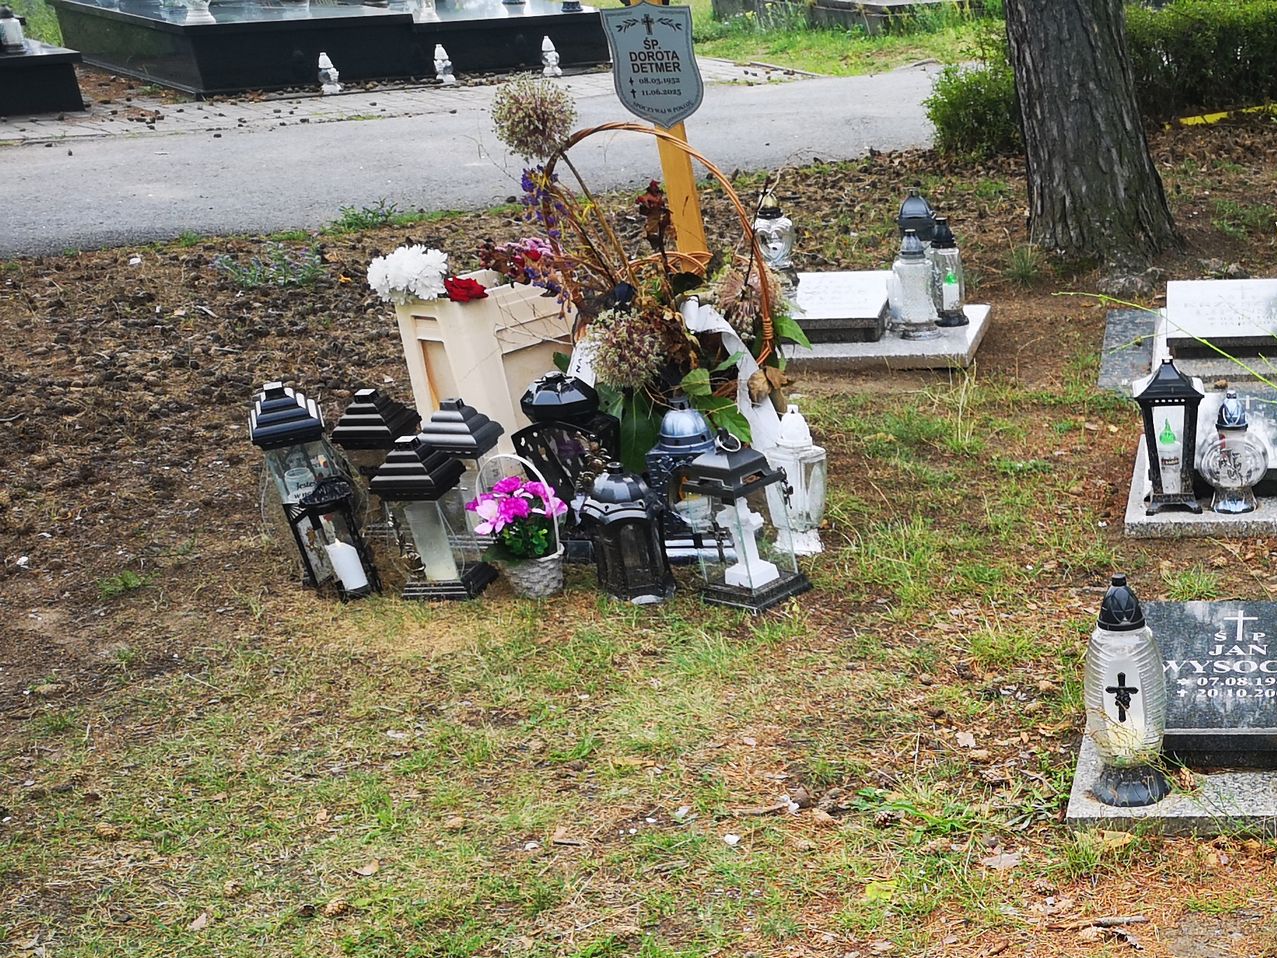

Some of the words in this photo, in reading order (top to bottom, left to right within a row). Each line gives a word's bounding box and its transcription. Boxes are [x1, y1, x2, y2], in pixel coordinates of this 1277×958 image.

[643, 37, 661, 50] ŚP.
[629, 51, 680, 62] DOROTA
[631, 62, 681, 73] DETMER
[1252, 632, 1266, 642] P
[1208, 644, 1268, 656] JAN
